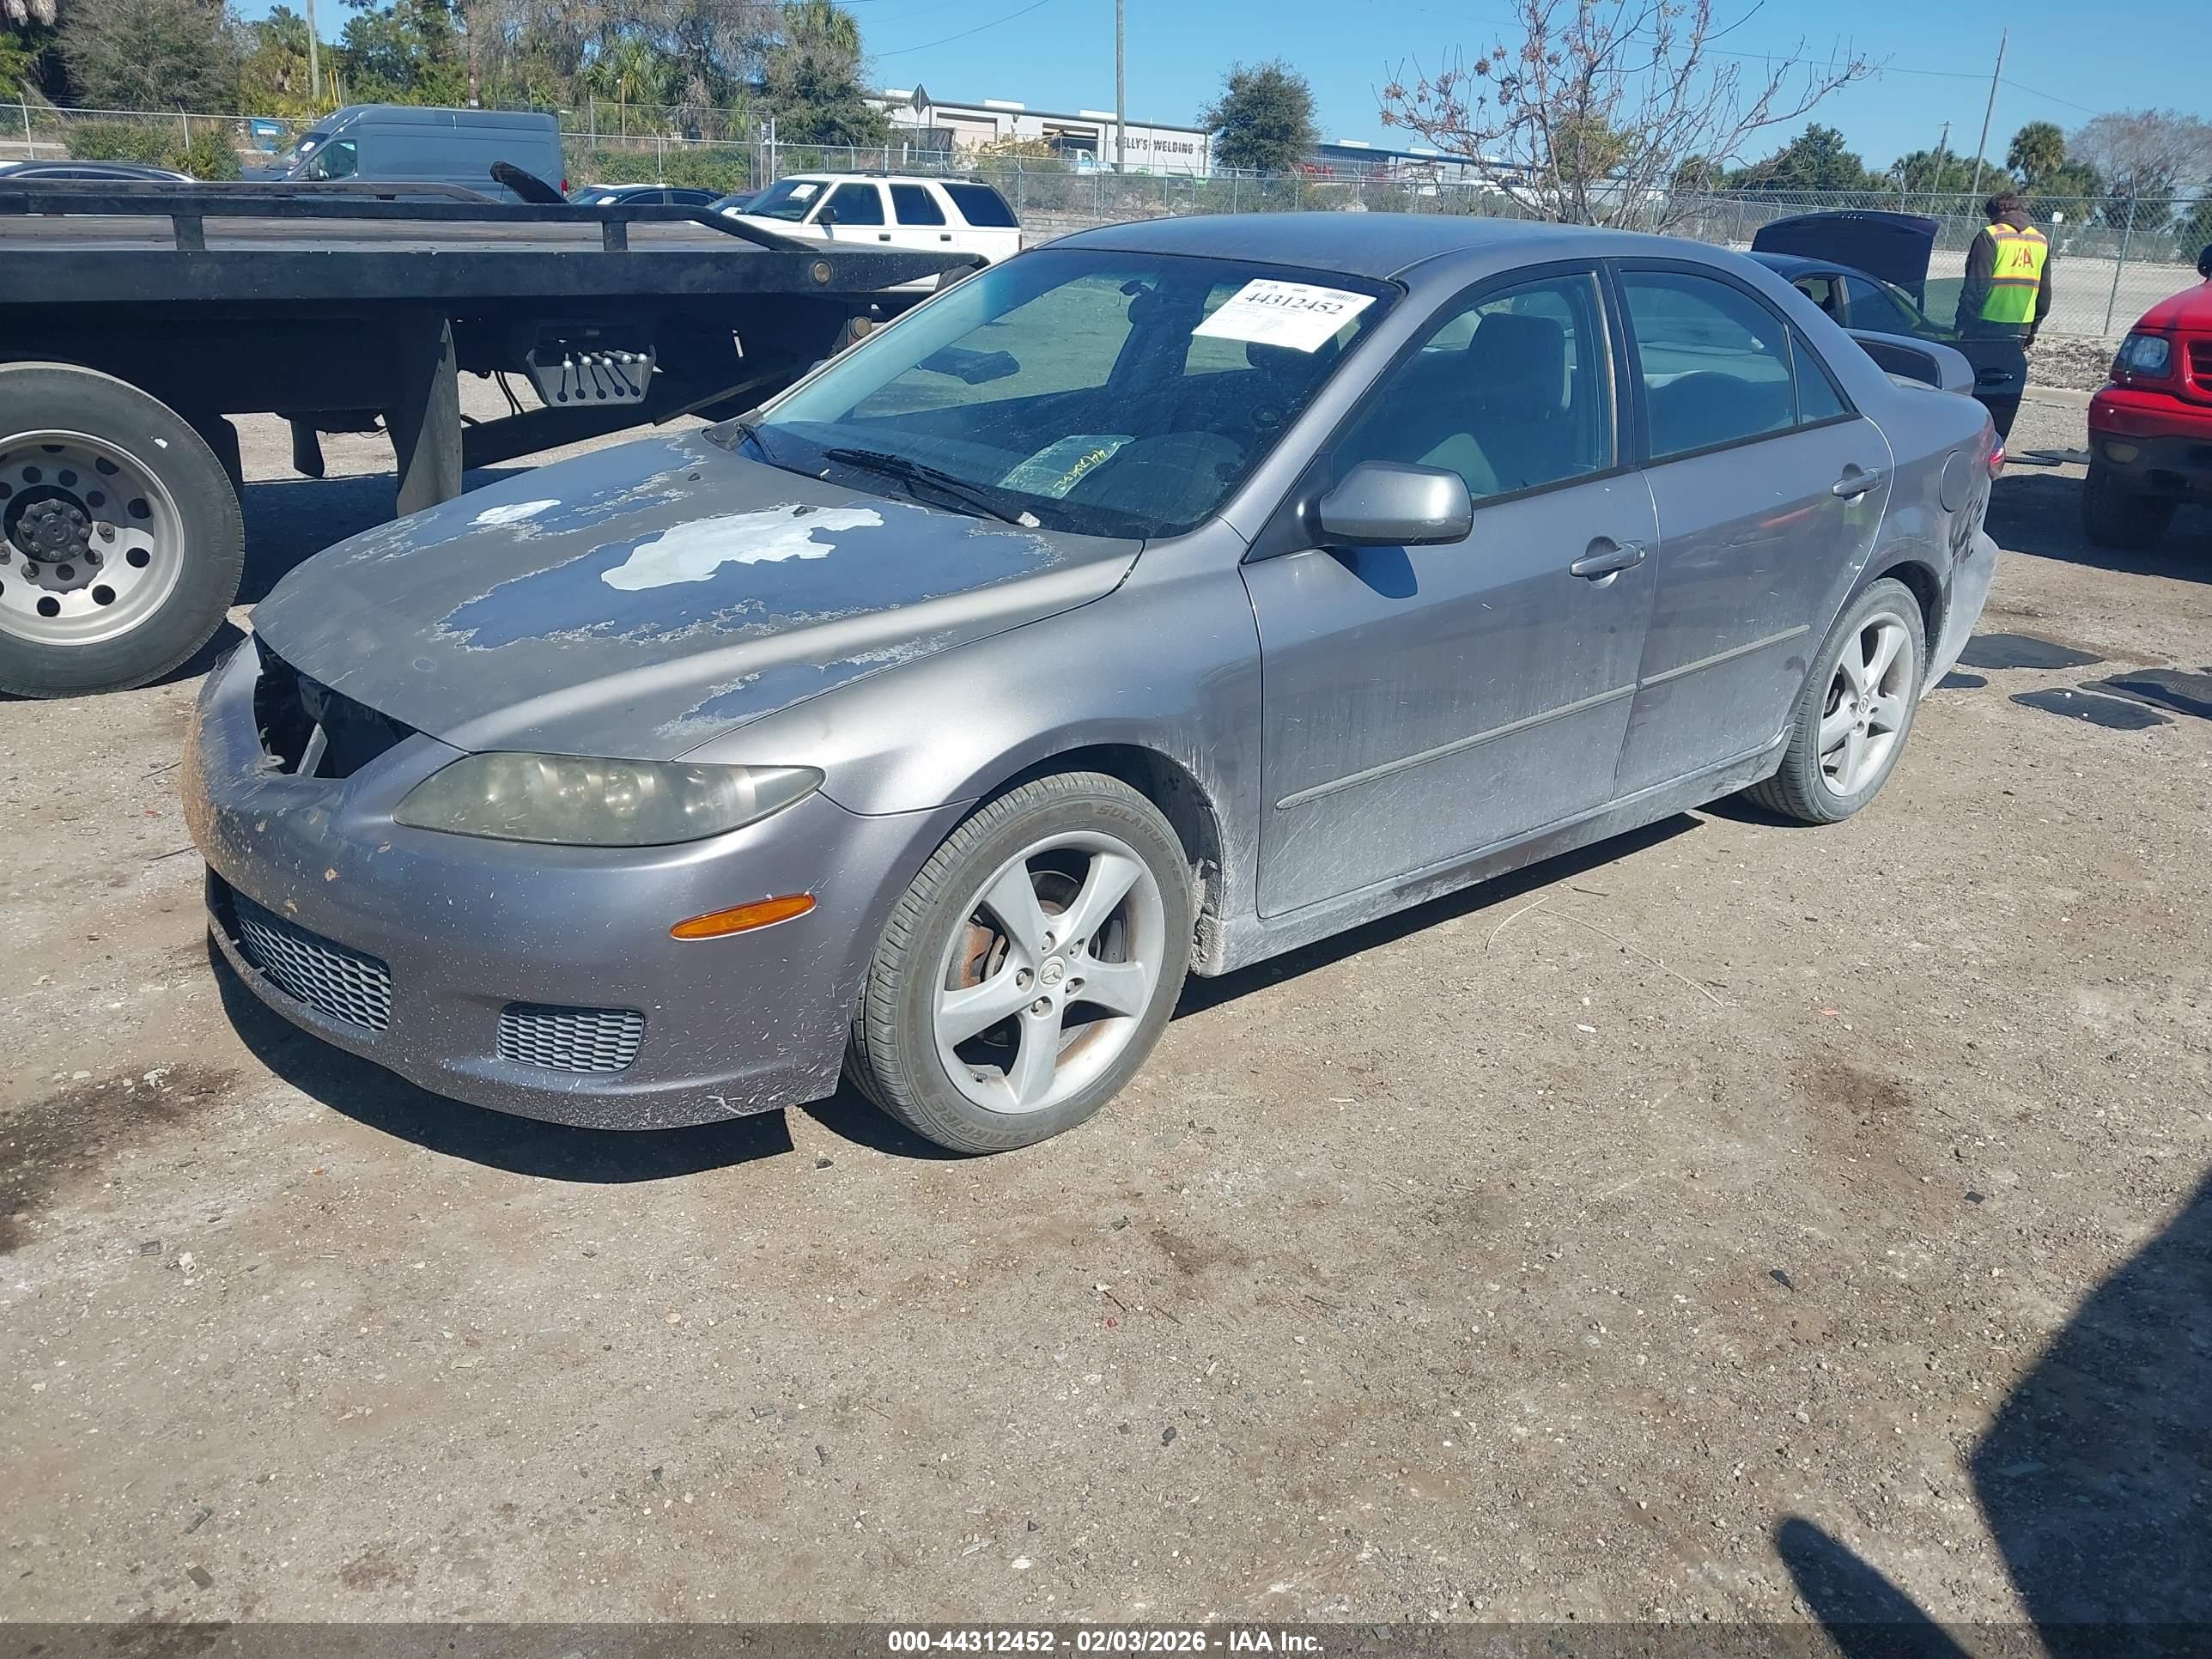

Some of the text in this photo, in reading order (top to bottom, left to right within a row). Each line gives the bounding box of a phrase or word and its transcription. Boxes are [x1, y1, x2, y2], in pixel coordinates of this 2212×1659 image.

[1115, 136, 1194, 155] LLY'S WELDING
[1244, 292, 1344, 314] 44312452
[1097, 805, 1170, 853] SOLARUS
[931, 1098, 1029, 1144] STARFIRE
